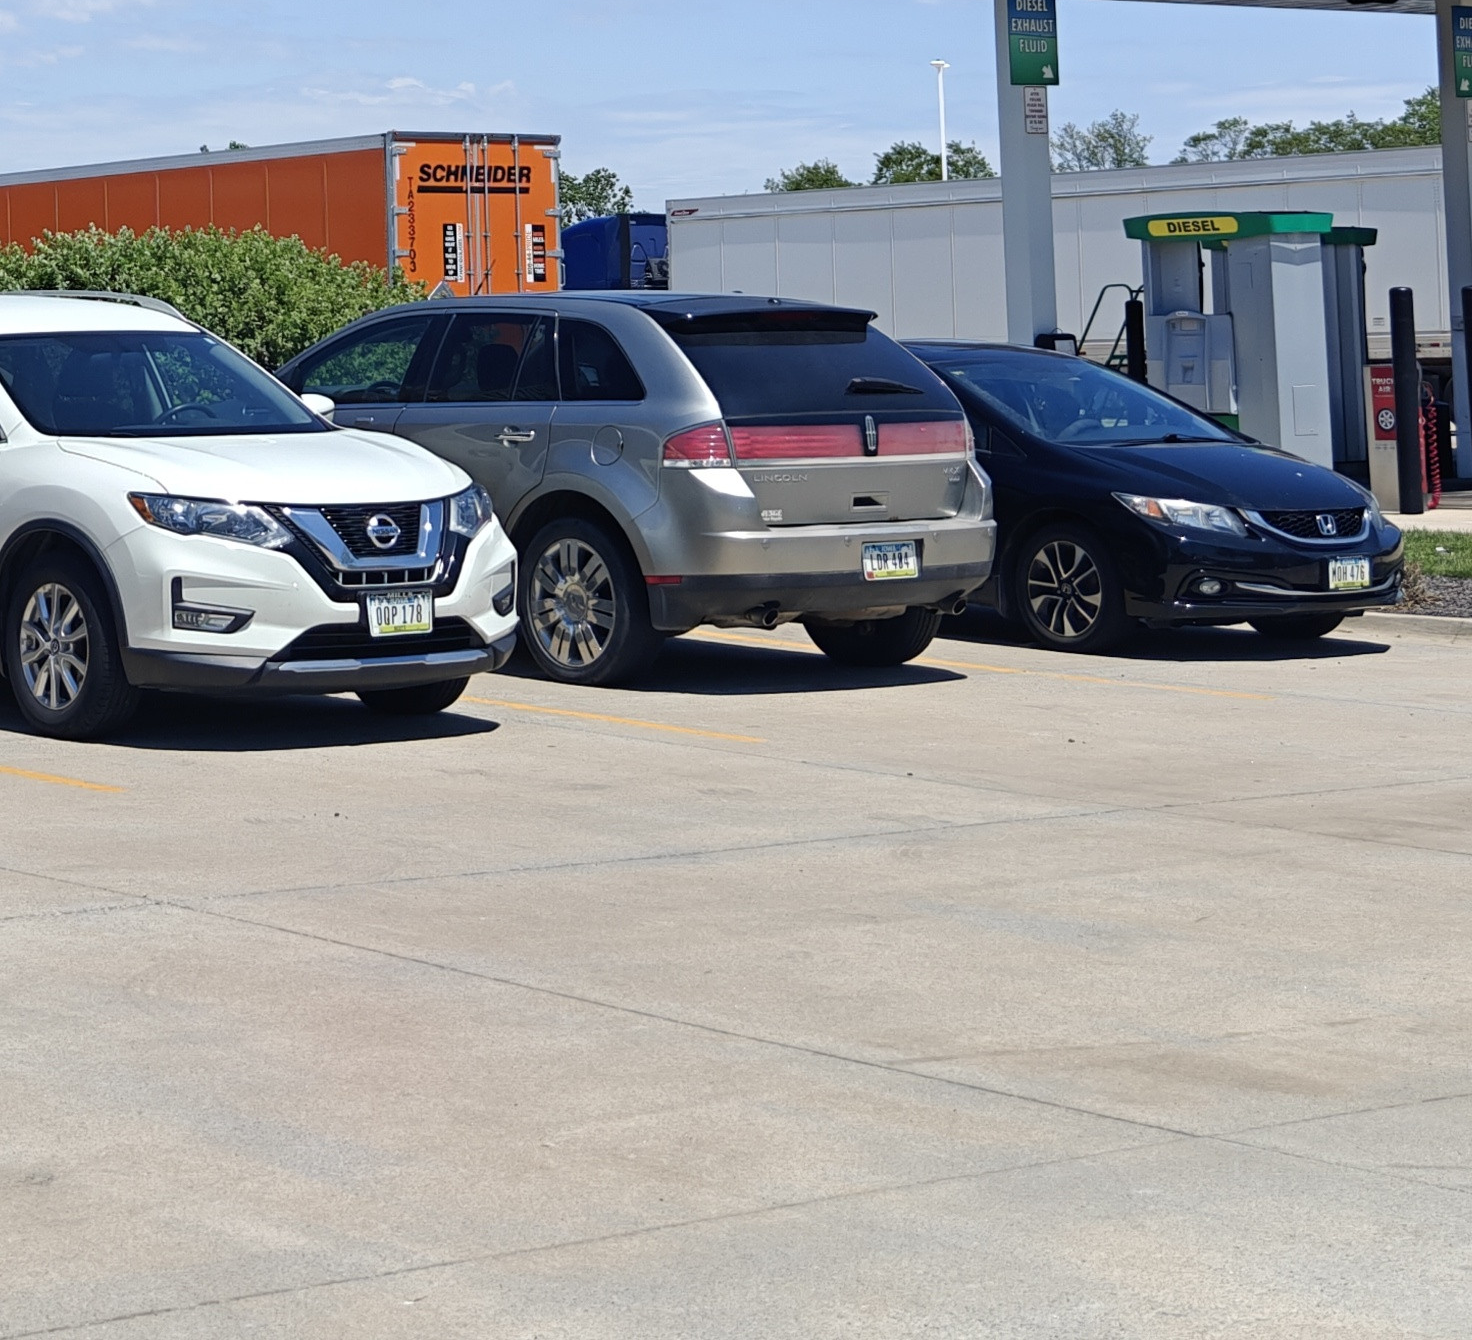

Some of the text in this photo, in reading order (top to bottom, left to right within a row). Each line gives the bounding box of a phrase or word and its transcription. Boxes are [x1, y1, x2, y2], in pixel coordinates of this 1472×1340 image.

[1011, 18, 1054, 33] EXHAUST
[1019, 39, 1048, 53] FLUID
[418, 164, 532, 183] SCHNEIDER
[1166, 220, 1220, 233] DIESEL
[1350, 564, 1365, 581] 476
[402, 604, 423, 624] 178
